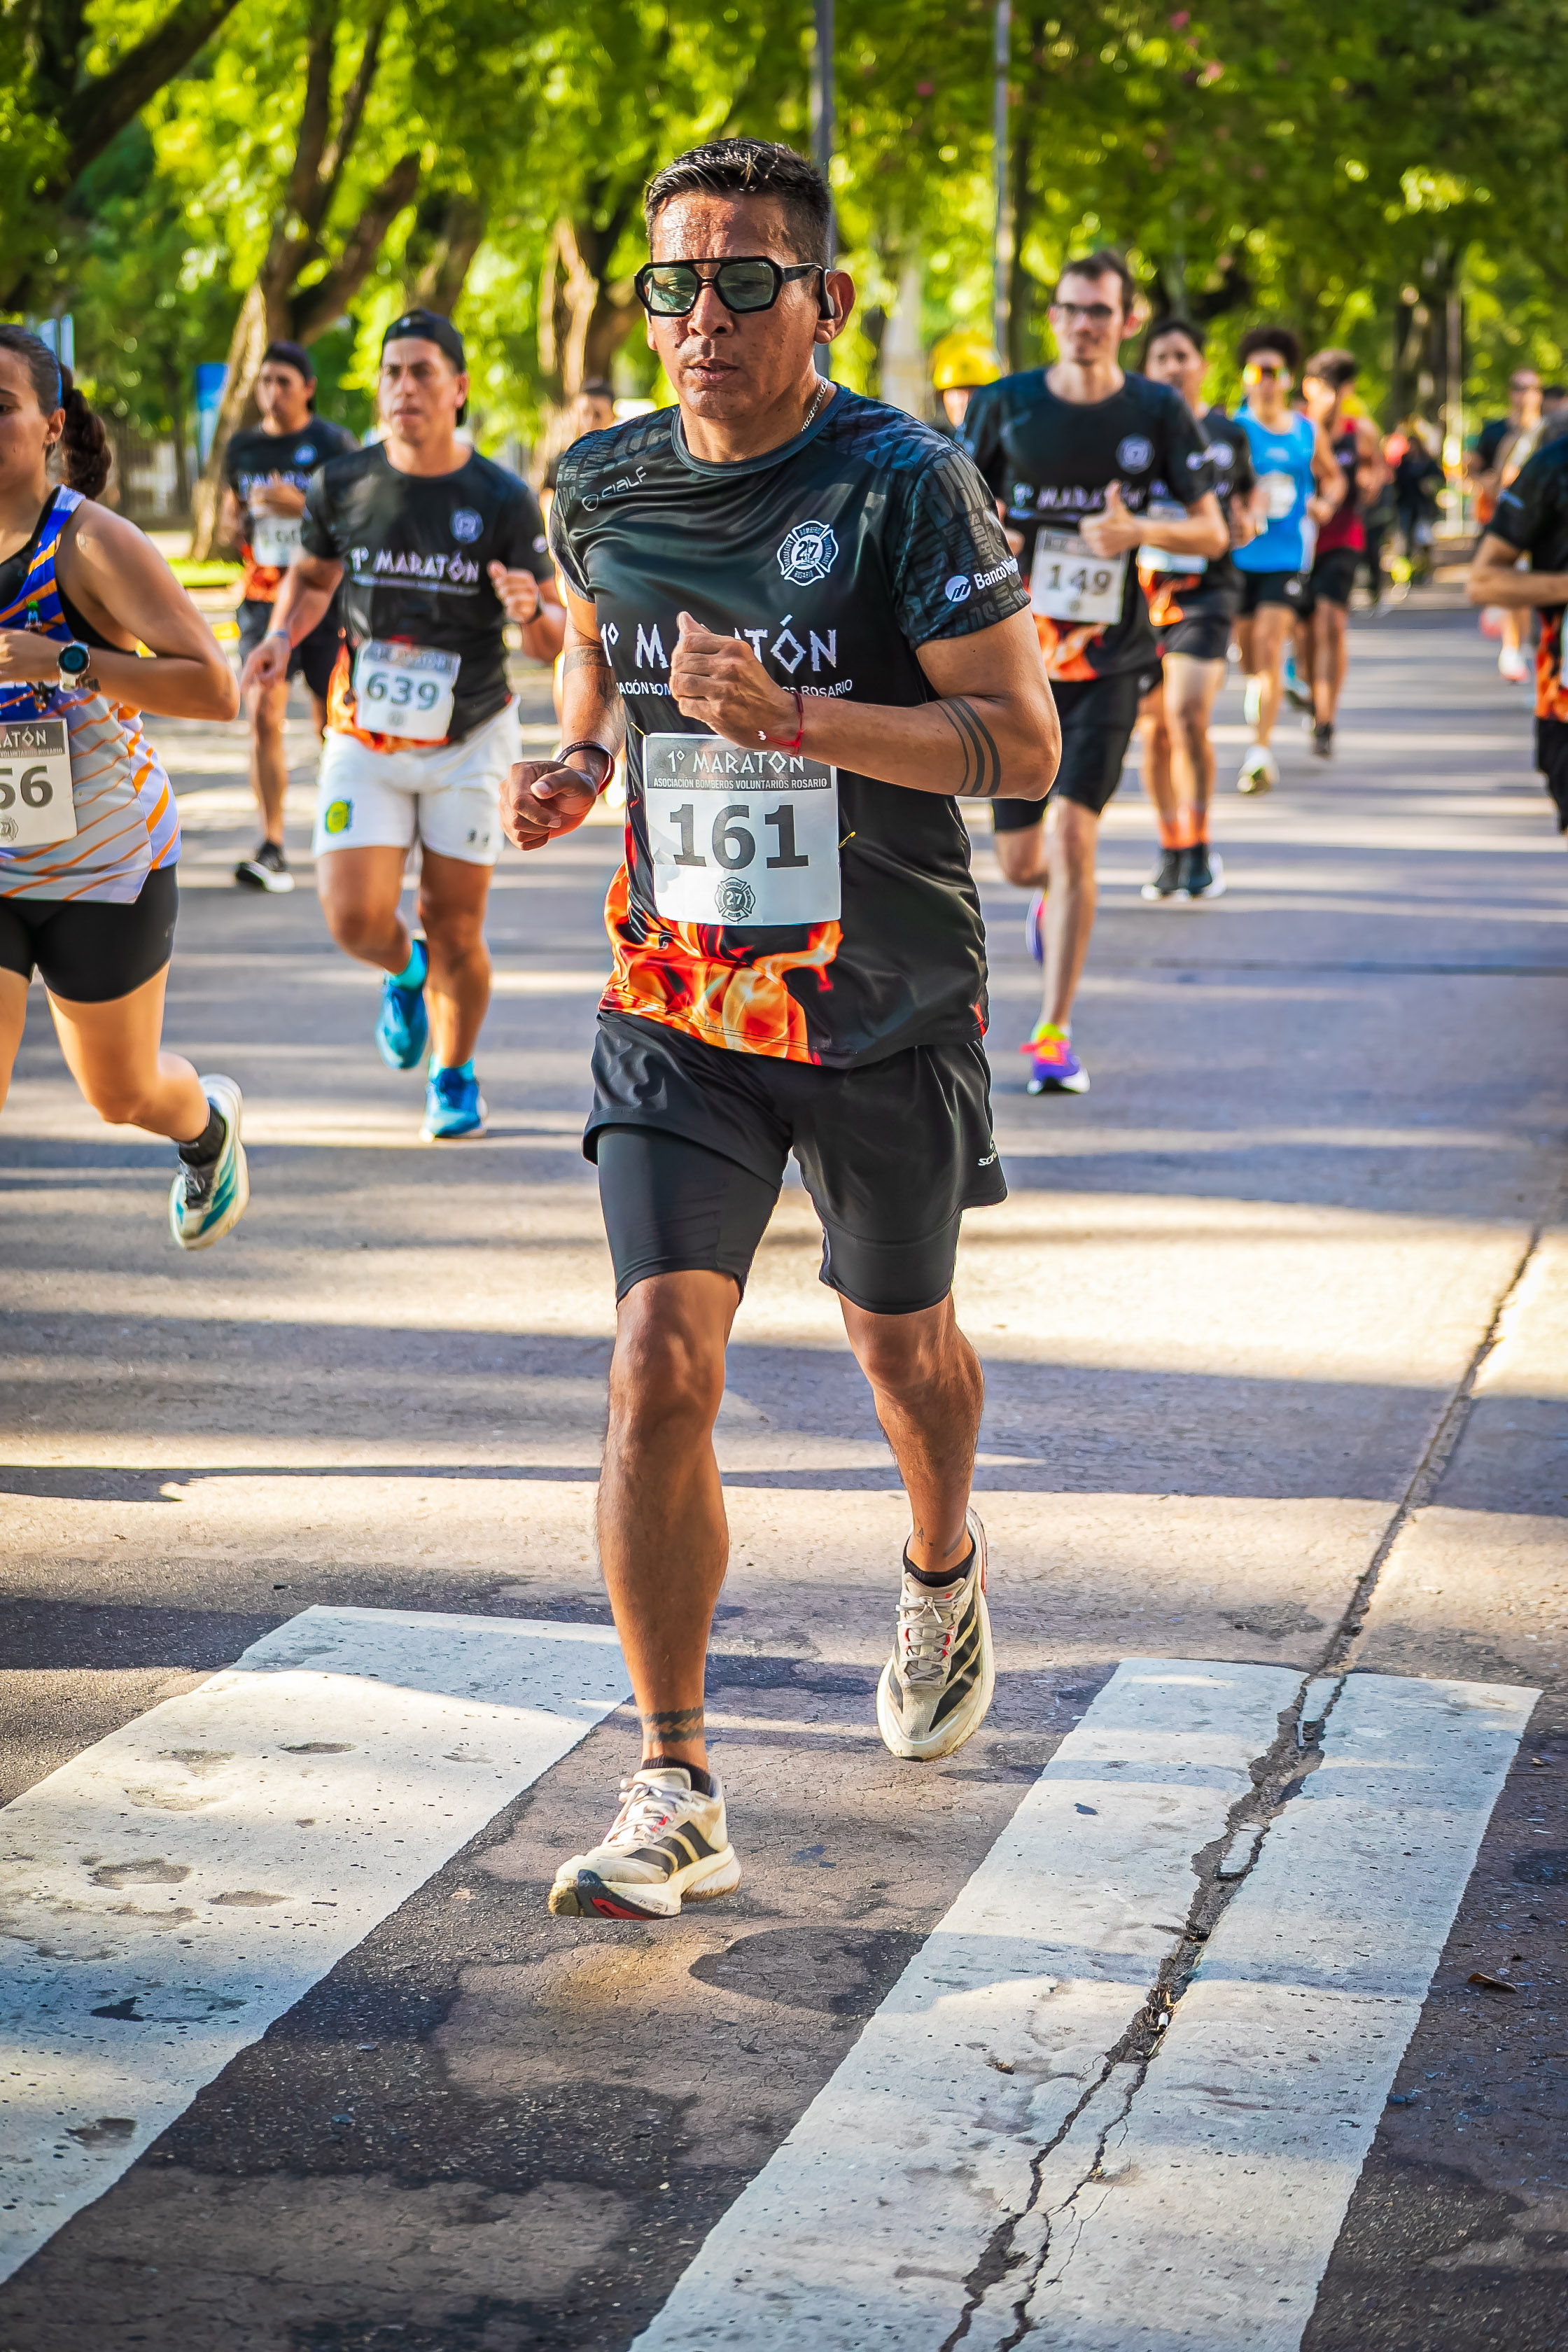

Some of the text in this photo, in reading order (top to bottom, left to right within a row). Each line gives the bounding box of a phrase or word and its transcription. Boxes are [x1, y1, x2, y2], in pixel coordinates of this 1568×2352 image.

[1047, 564, 1113, 596] 149
[367, 671, 440, 711] 639
[0, 724, 47, 749] ATÓN
[695, 778, 734, 790] BOMBEROS
[736, 778, 790, 790] VOLUNTARIOS
[791, 778, 827, 789] ROSARIO
[670, 804, 809, 870] 161
[726, 890, 743, 906] 27
